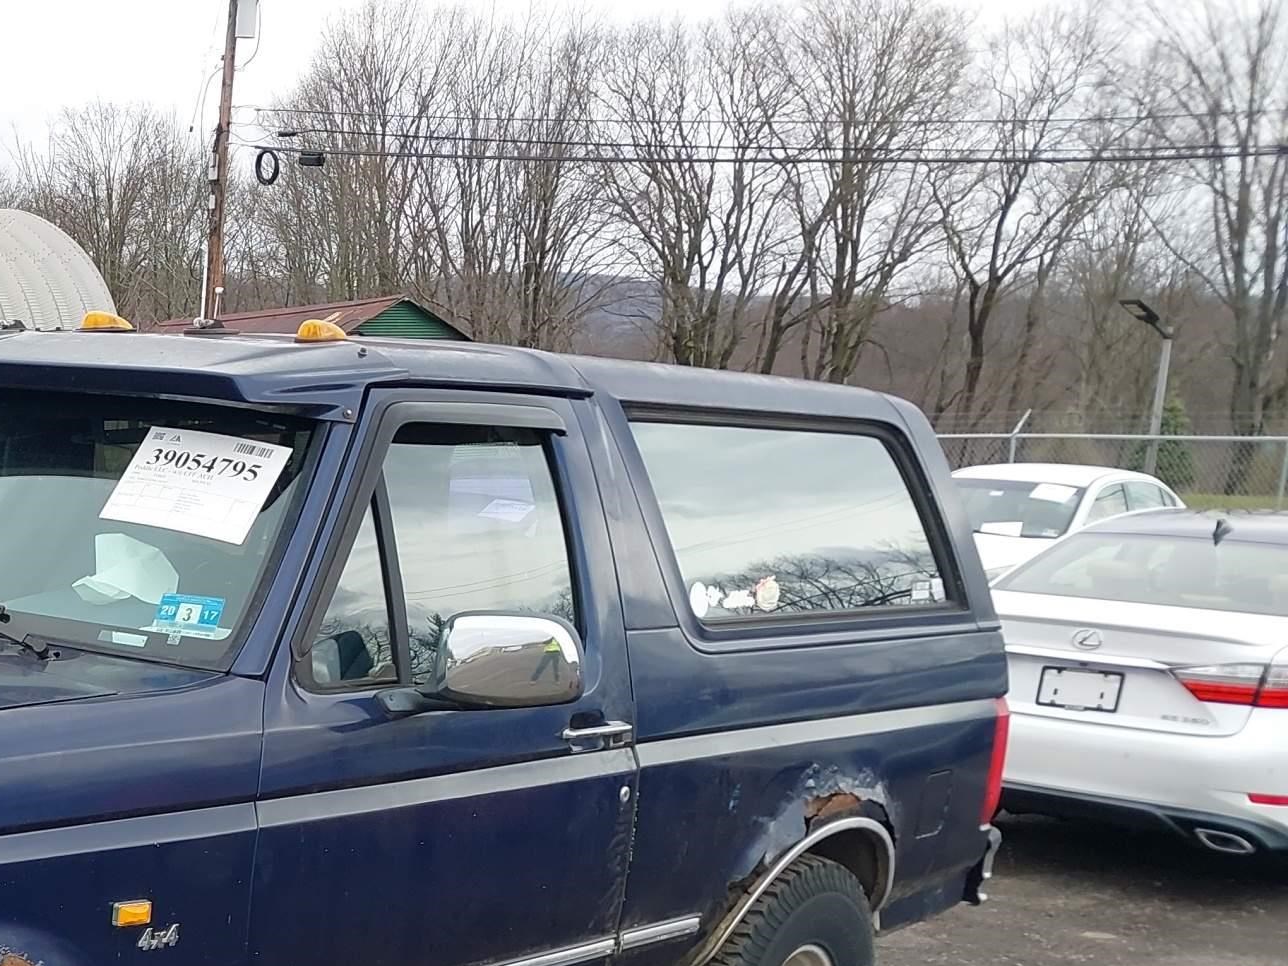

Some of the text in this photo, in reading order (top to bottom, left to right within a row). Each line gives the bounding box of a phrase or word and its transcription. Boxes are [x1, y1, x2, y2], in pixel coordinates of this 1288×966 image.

[146, 448, 263, 481] 39054795
[159, 605, 219, 622] 20 3 17
[137, 923, 180, 951] 4x4
